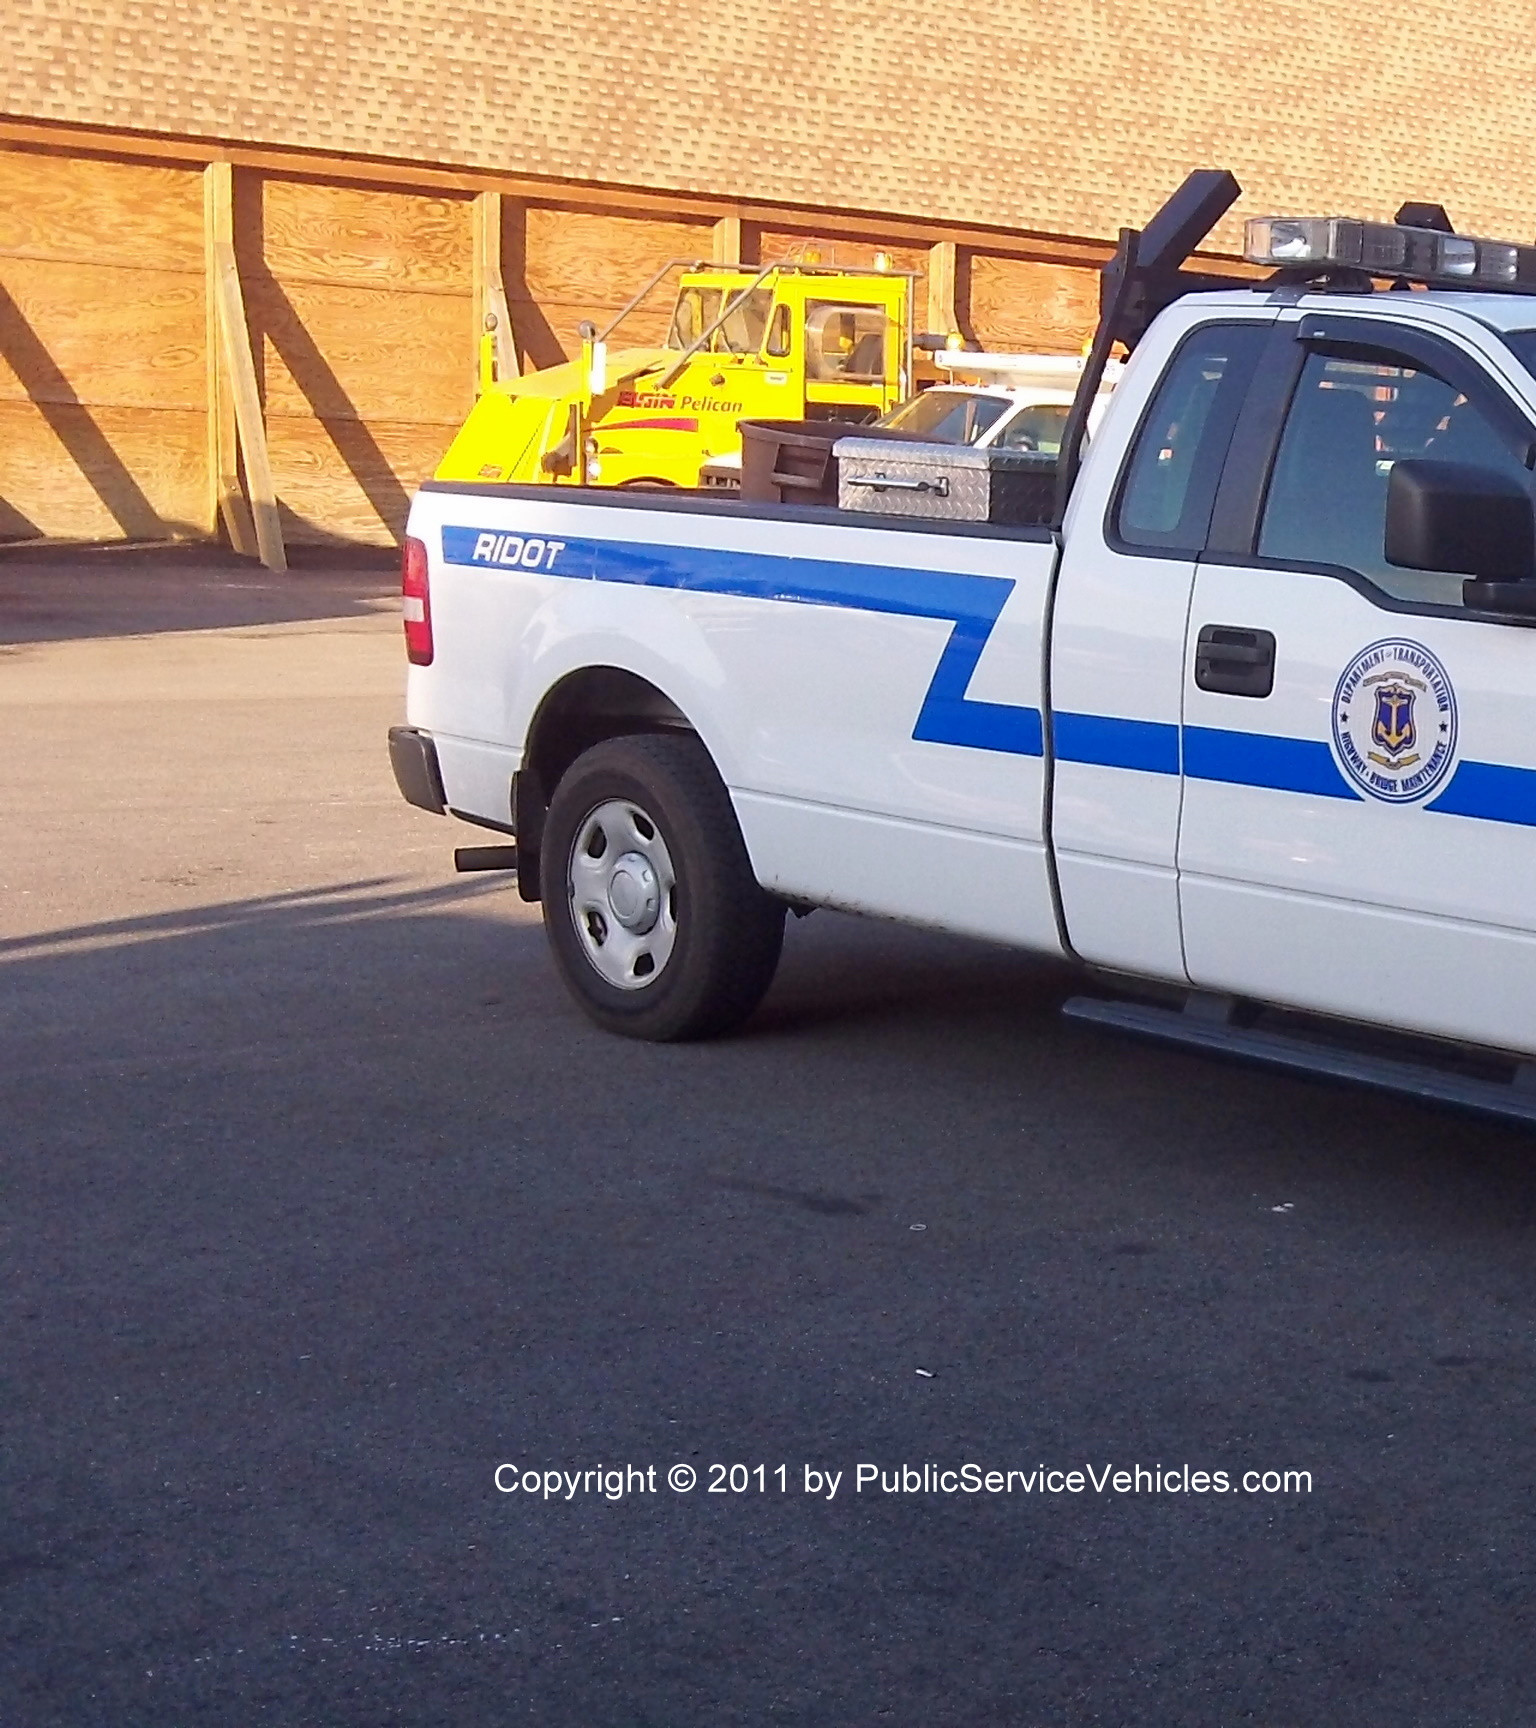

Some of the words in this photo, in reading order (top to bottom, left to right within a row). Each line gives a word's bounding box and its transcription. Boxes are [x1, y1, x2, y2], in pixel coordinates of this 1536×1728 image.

[680, 396, 743, 412] Pelican
[472, 533, 566, 570] RIDOT
[1341, 649, 1385, 704] DEPARTMENT
[1393, 647, 1449, 712] TRANSPORTATION
[1341, 731, 1368, 775] HIGHWAY
[1401, 740, 1447, 792] MAINTENANCE
